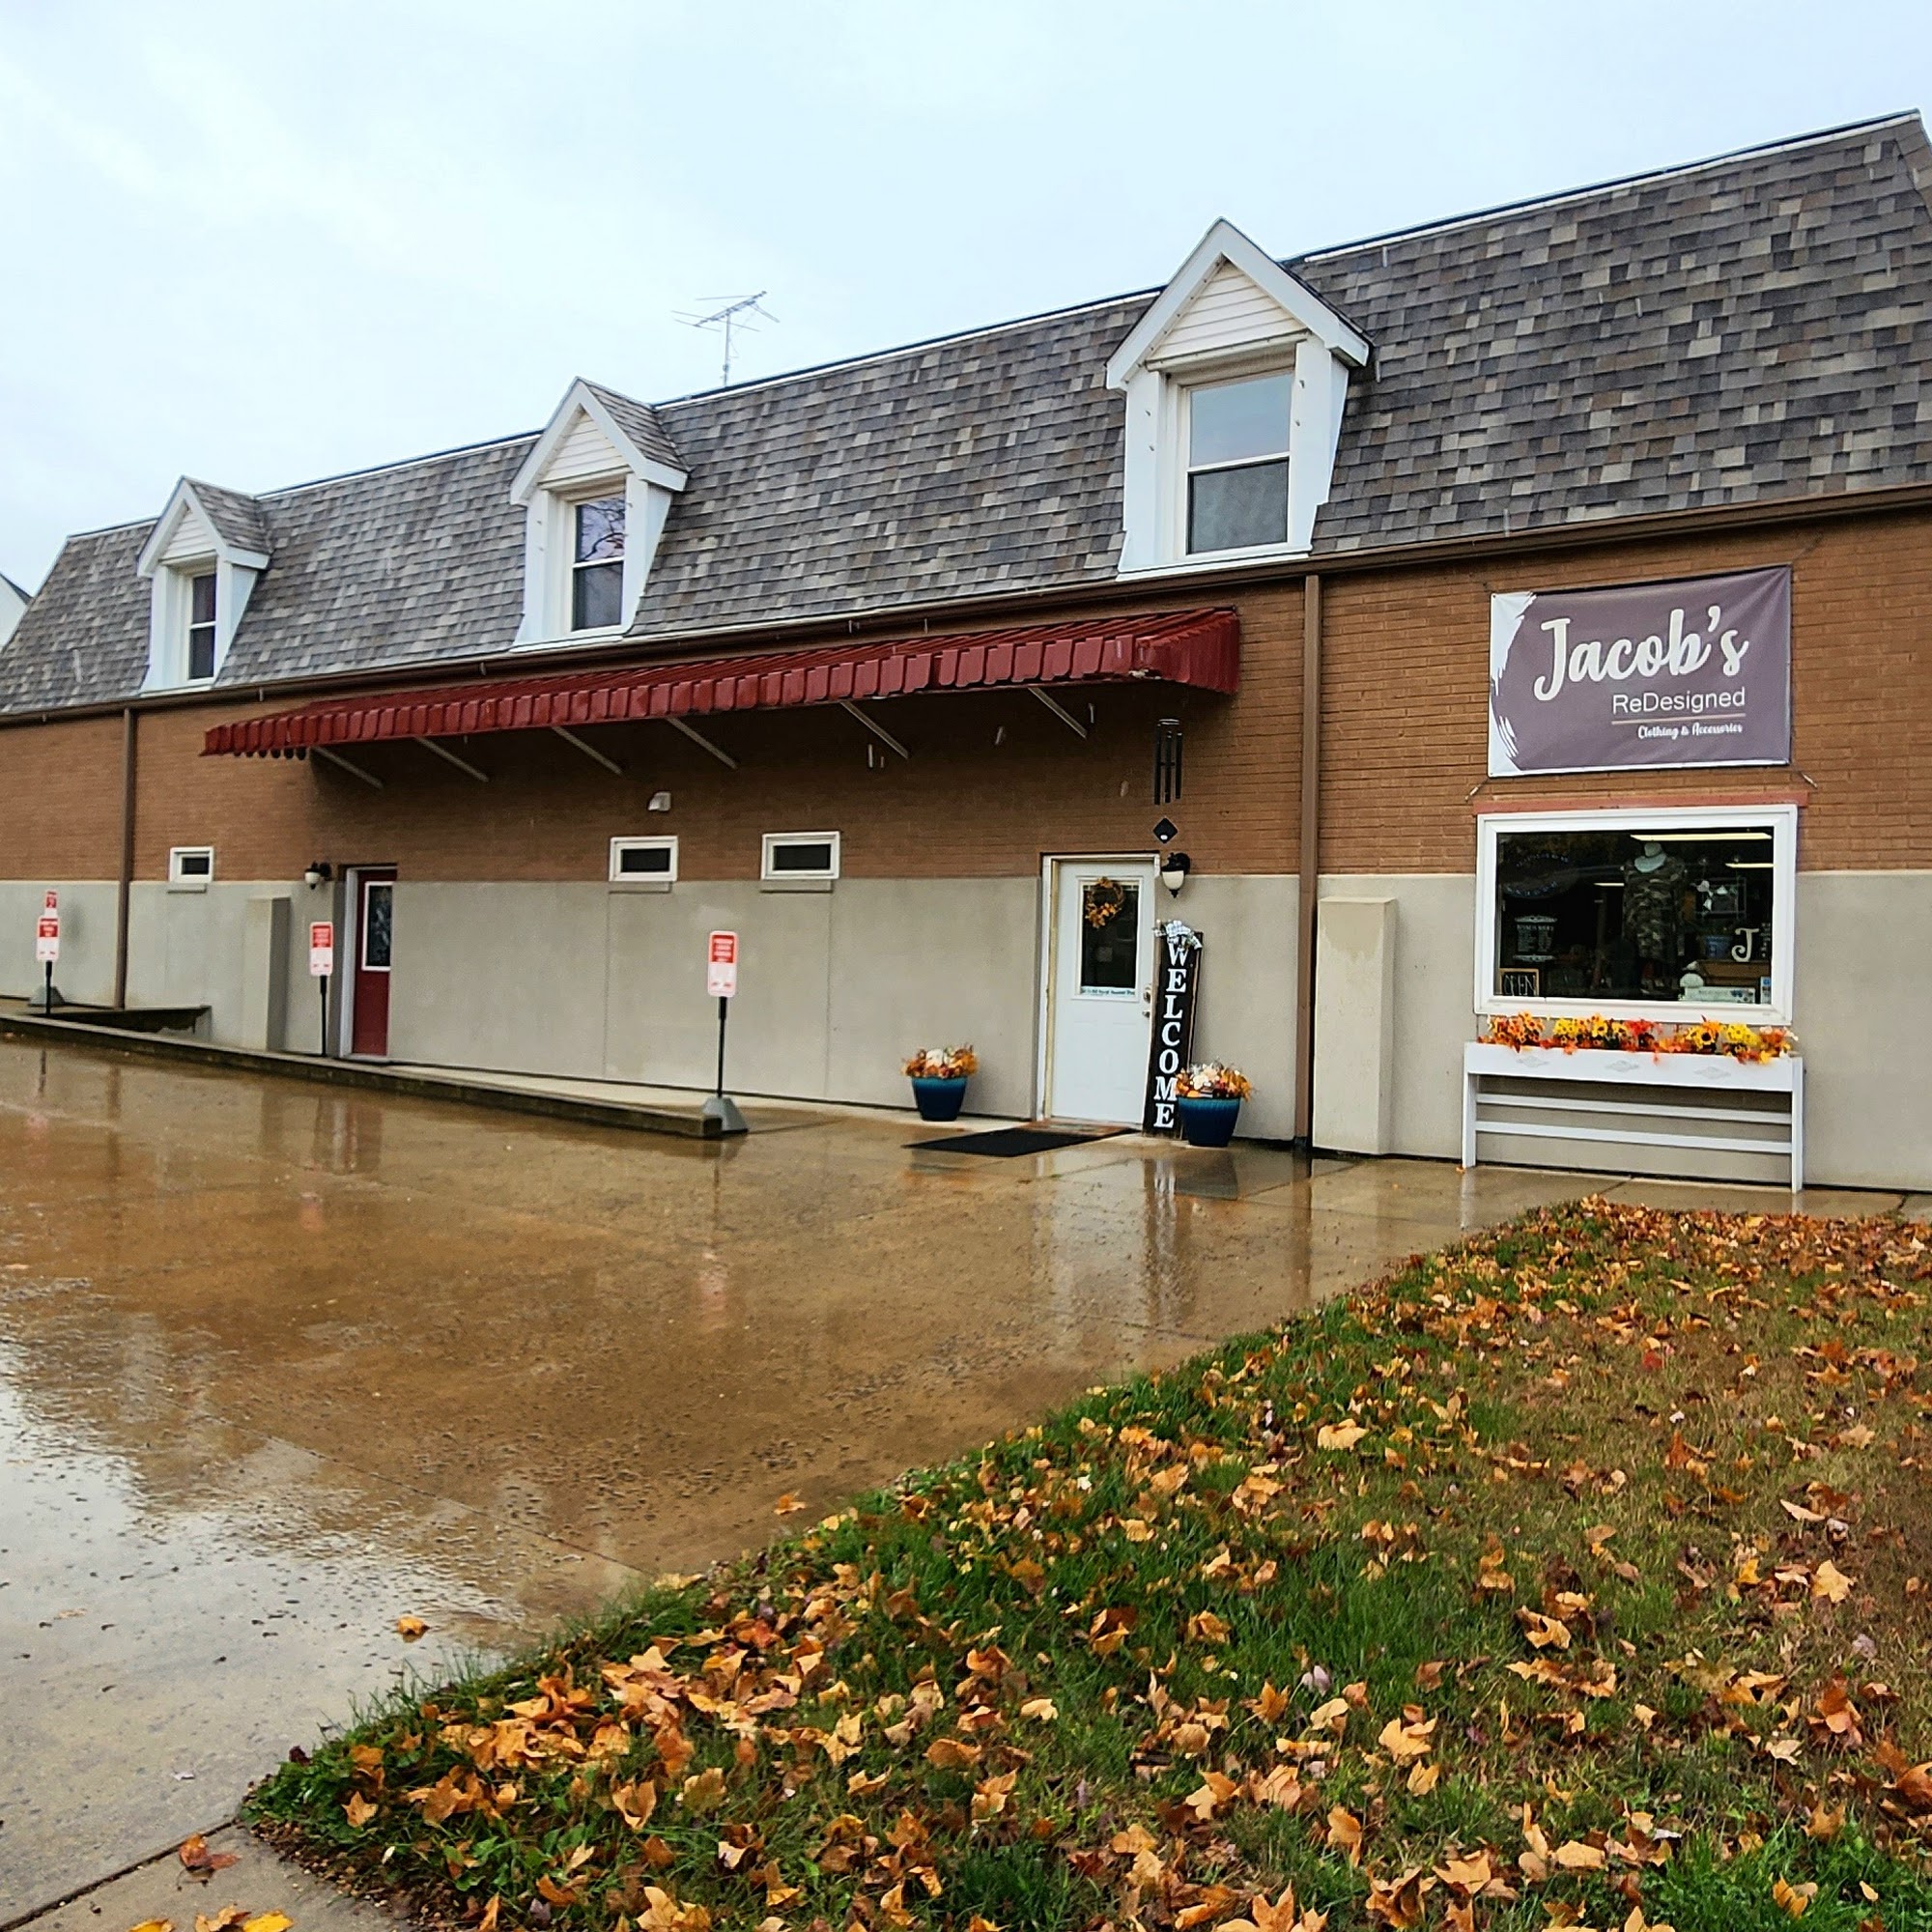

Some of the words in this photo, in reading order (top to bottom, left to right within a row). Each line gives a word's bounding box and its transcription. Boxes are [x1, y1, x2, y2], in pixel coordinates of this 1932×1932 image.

[1534, 606, 1749, 701] Jacob's
[1612, 687, 1746, 715] ReDesigned
[1637, 724, 1679, 740] Clothing
[1691, 722, 1743, 736] Accessories
[1153, 937, 1189, 1128] WELCOME
